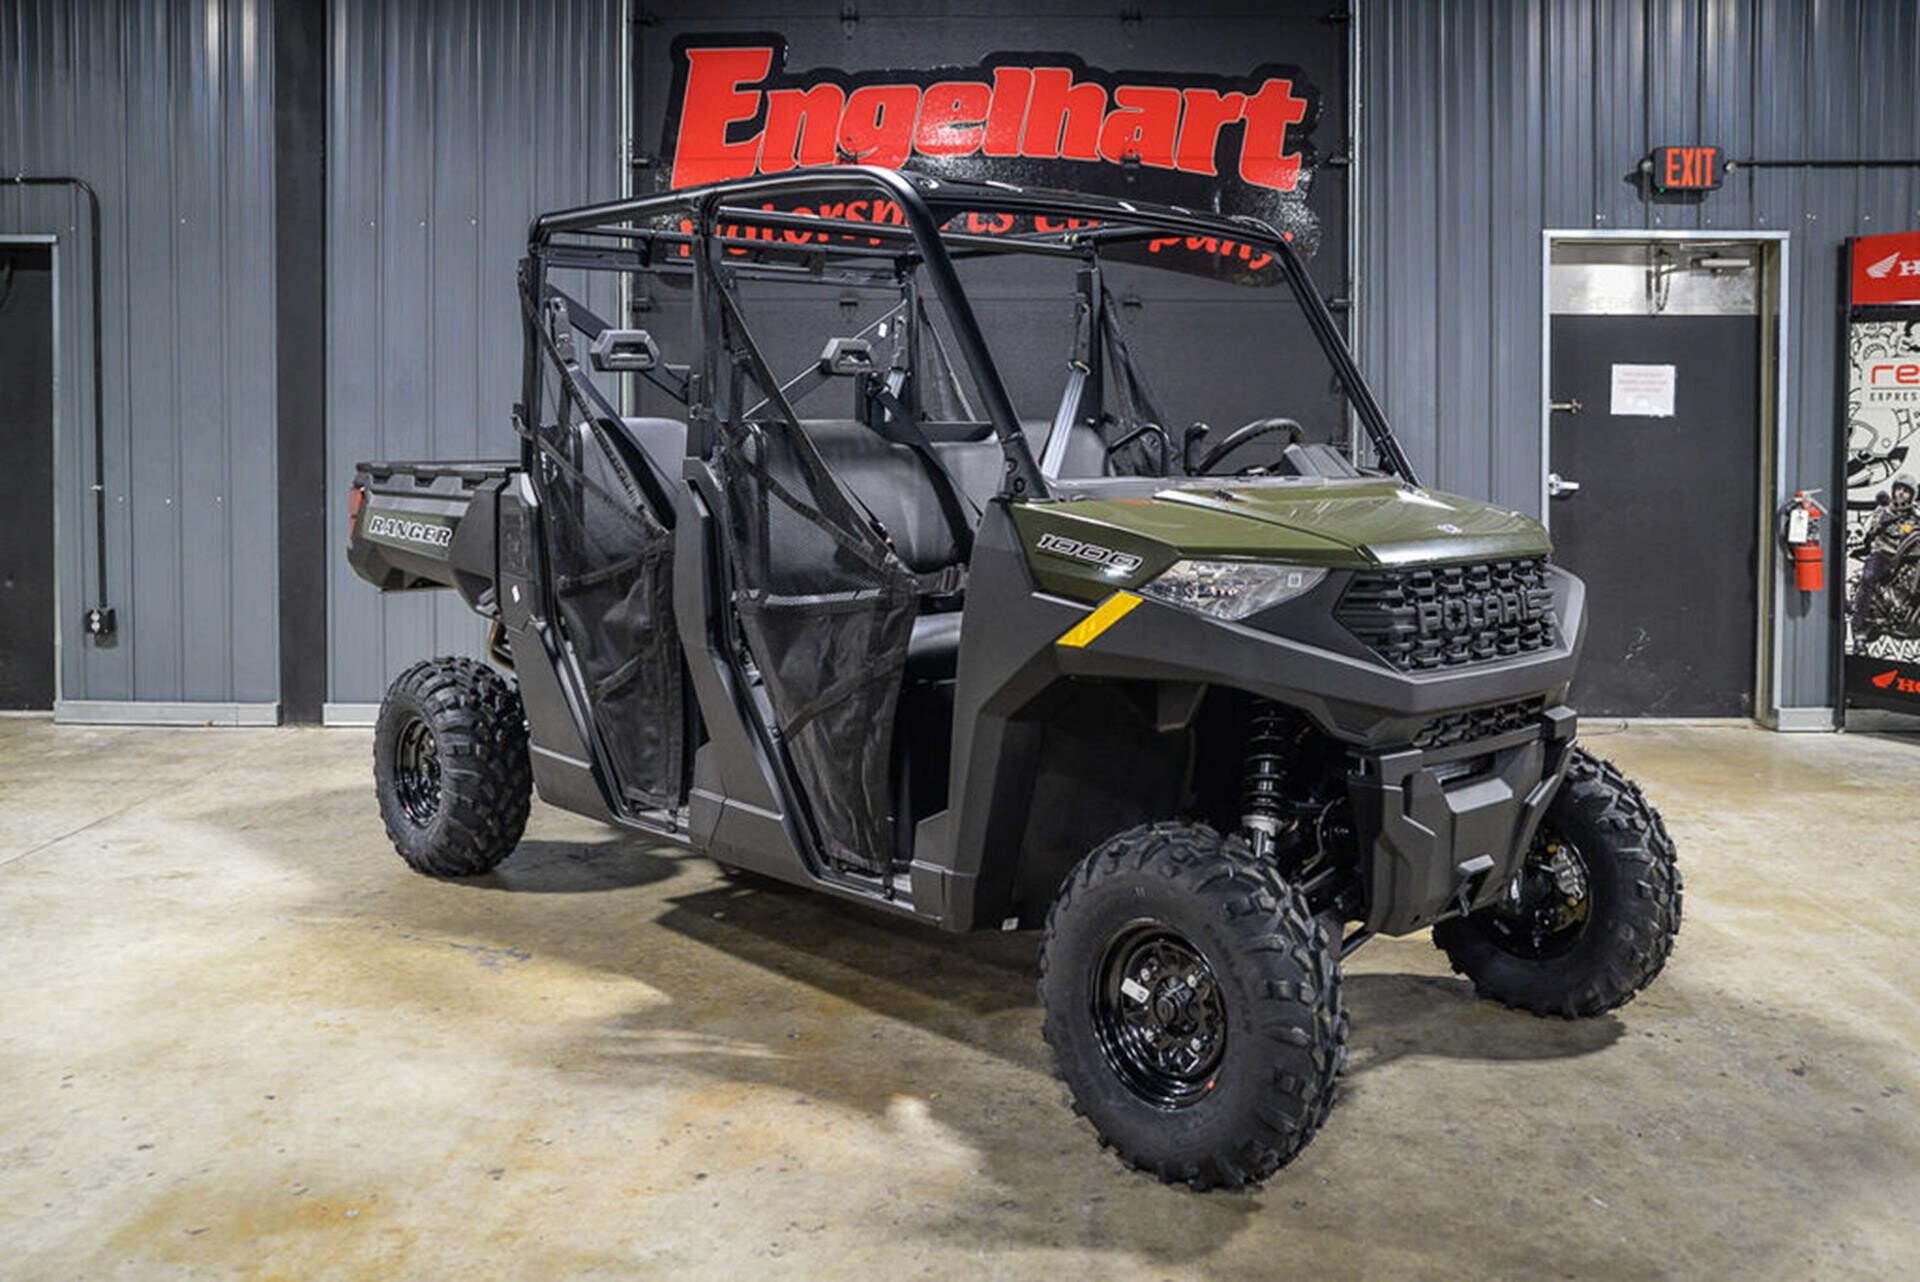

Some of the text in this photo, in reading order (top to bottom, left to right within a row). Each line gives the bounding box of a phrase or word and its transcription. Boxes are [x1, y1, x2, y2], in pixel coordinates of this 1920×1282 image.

[670, 47, 1308, 191] Engelhart
[1665, 147, 1717, 187] EXIT
[680, 200, 1015, 257] otorspts
[369, 515, 452, 546] RANGER
[1036, 532, 1143, 573] 1000
[1418, 587, 1553, 634] POLARIS
